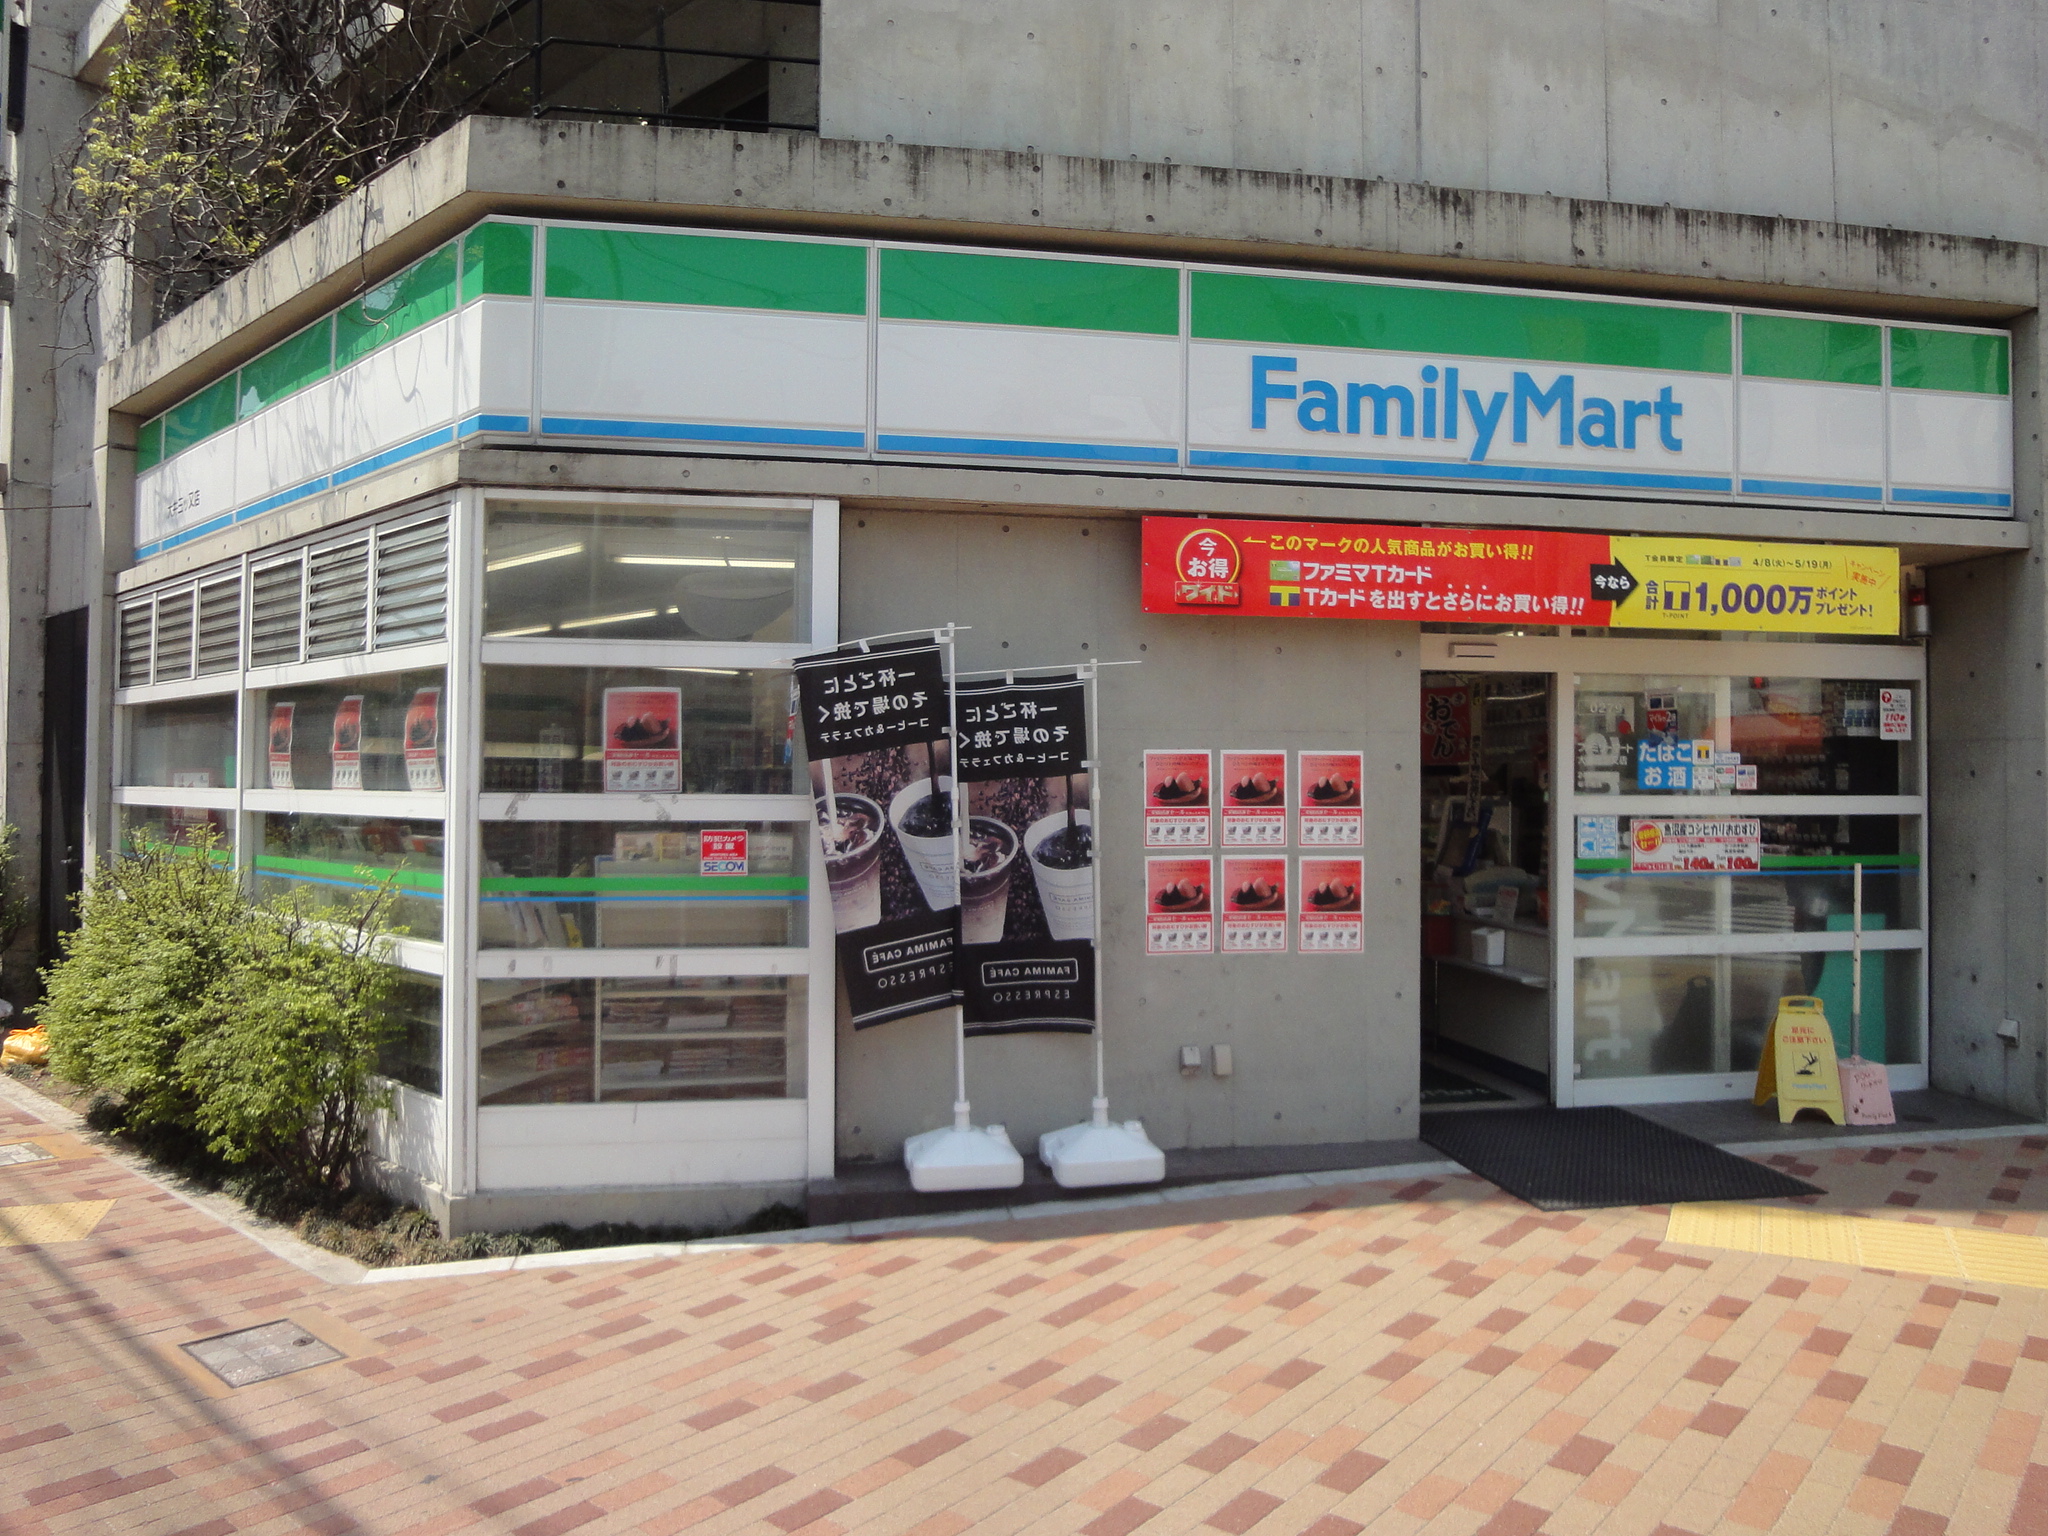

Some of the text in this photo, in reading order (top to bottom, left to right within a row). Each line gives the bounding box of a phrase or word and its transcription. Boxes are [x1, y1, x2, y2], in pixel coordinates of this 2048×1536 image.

[1250, 354, 1683, 463] FamilyMart
[1198, 536, 1218, 557] 今
[1269, 534, 1534, 561] このマークの人気商品がお買い得!!
[1187, 556, 1229, 579] お得
[1302, 562, 1433, 585] ファミマTカード
[1593, 574, 1632, 591] 今なら
[1180, 584, 1234, 603] ワイド
[1304, 585, 1584, 616] Tカードを出すとさらにお買い得!!
[1644, 579, 1660, 611] 合計
[1694, 581, 1815, 617] 1,000万
[1815, 587, 1858, 601] ポイント
[1815, 602, 1874, 618] プレゼント!
[1644, 766, 1687, 787] お酒
[703, 835, 745, 843] 防犯カメラ
[712, 842, 736, 850] 設置
[703, 861, 745, 872] SECOM
